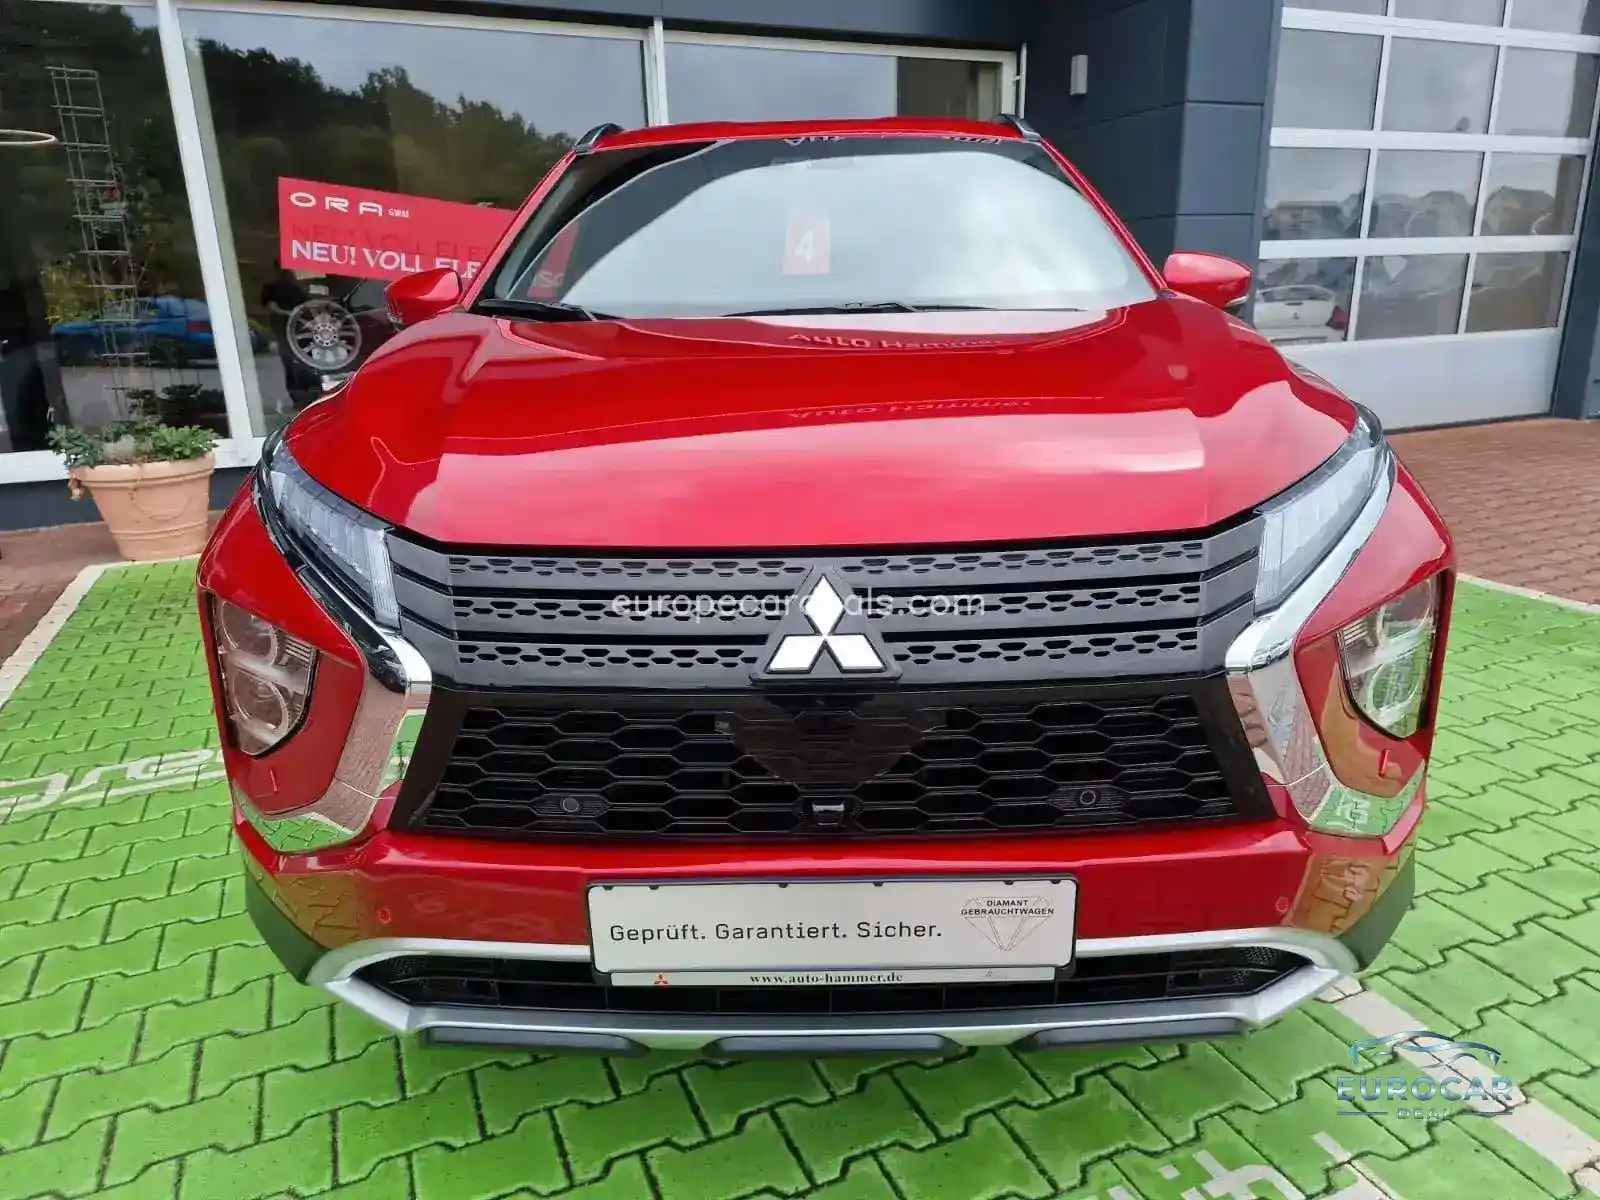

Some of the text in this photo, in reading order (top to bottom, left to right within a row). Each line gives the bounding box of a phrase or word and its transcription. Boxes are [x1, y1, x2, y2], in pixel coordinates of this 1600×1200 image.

[289, 191, 383, 217] ORA
[291, 239, 357, 266] NEU!
[362, 248, 424, 274] VOLL
[794, 229, 814, 263] 4
[960, 907, 1054, 915] GEBRAUCHTWAGEN
[609, 921, 943, 944] Geprüft. Garantiert. Sicher.
[749, 971, 904, 984] www.auto-hammer.de
